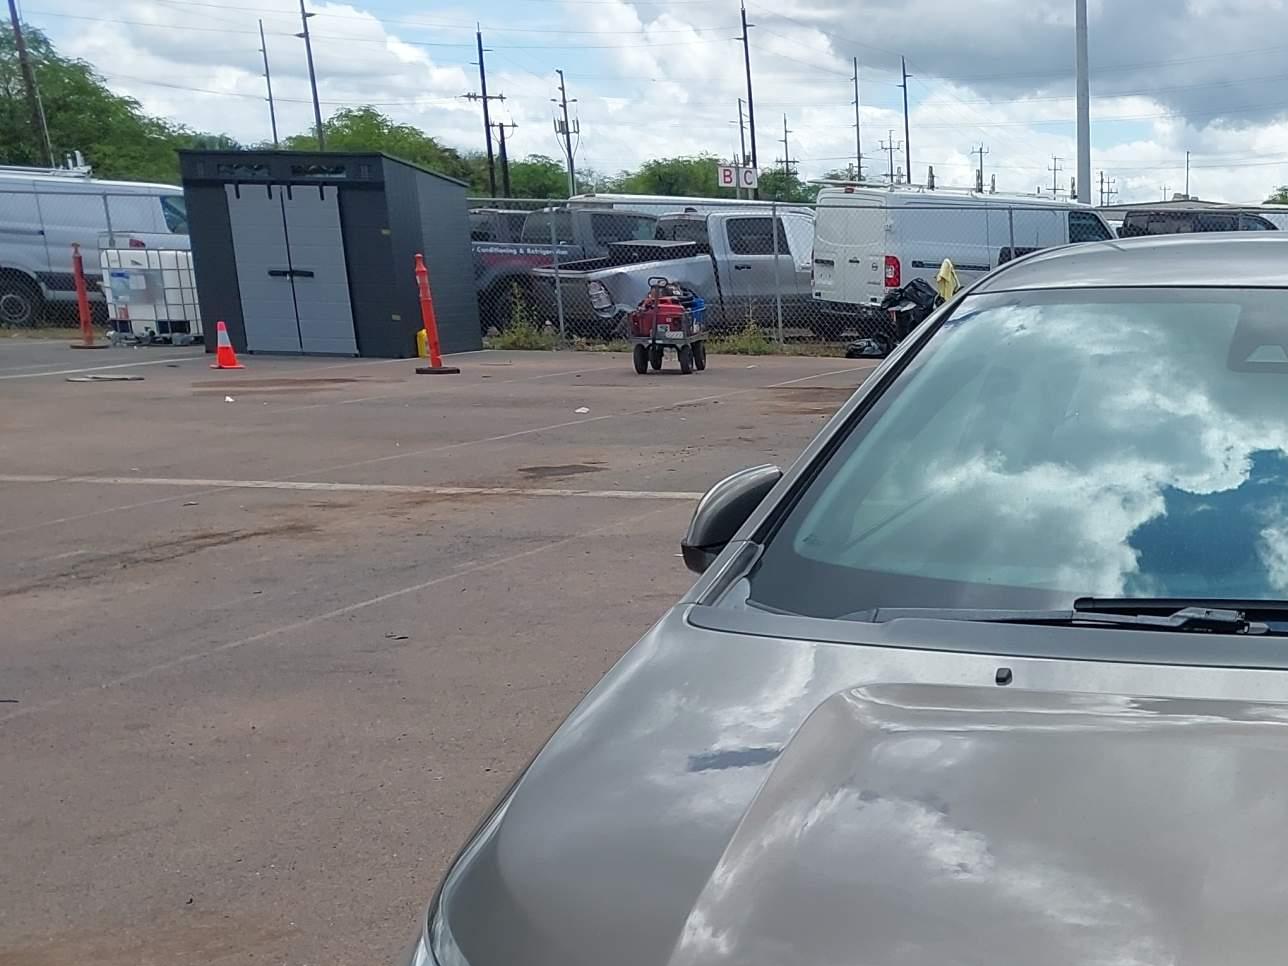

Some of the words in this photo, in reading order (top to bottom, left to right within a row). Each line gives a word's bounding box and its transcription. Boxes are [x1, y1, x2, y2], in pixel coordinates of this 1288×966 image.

[722, 168, 733, 184] B
[743, 169, 753, 186] C
[476, 246, 517, 255] Conditioning
